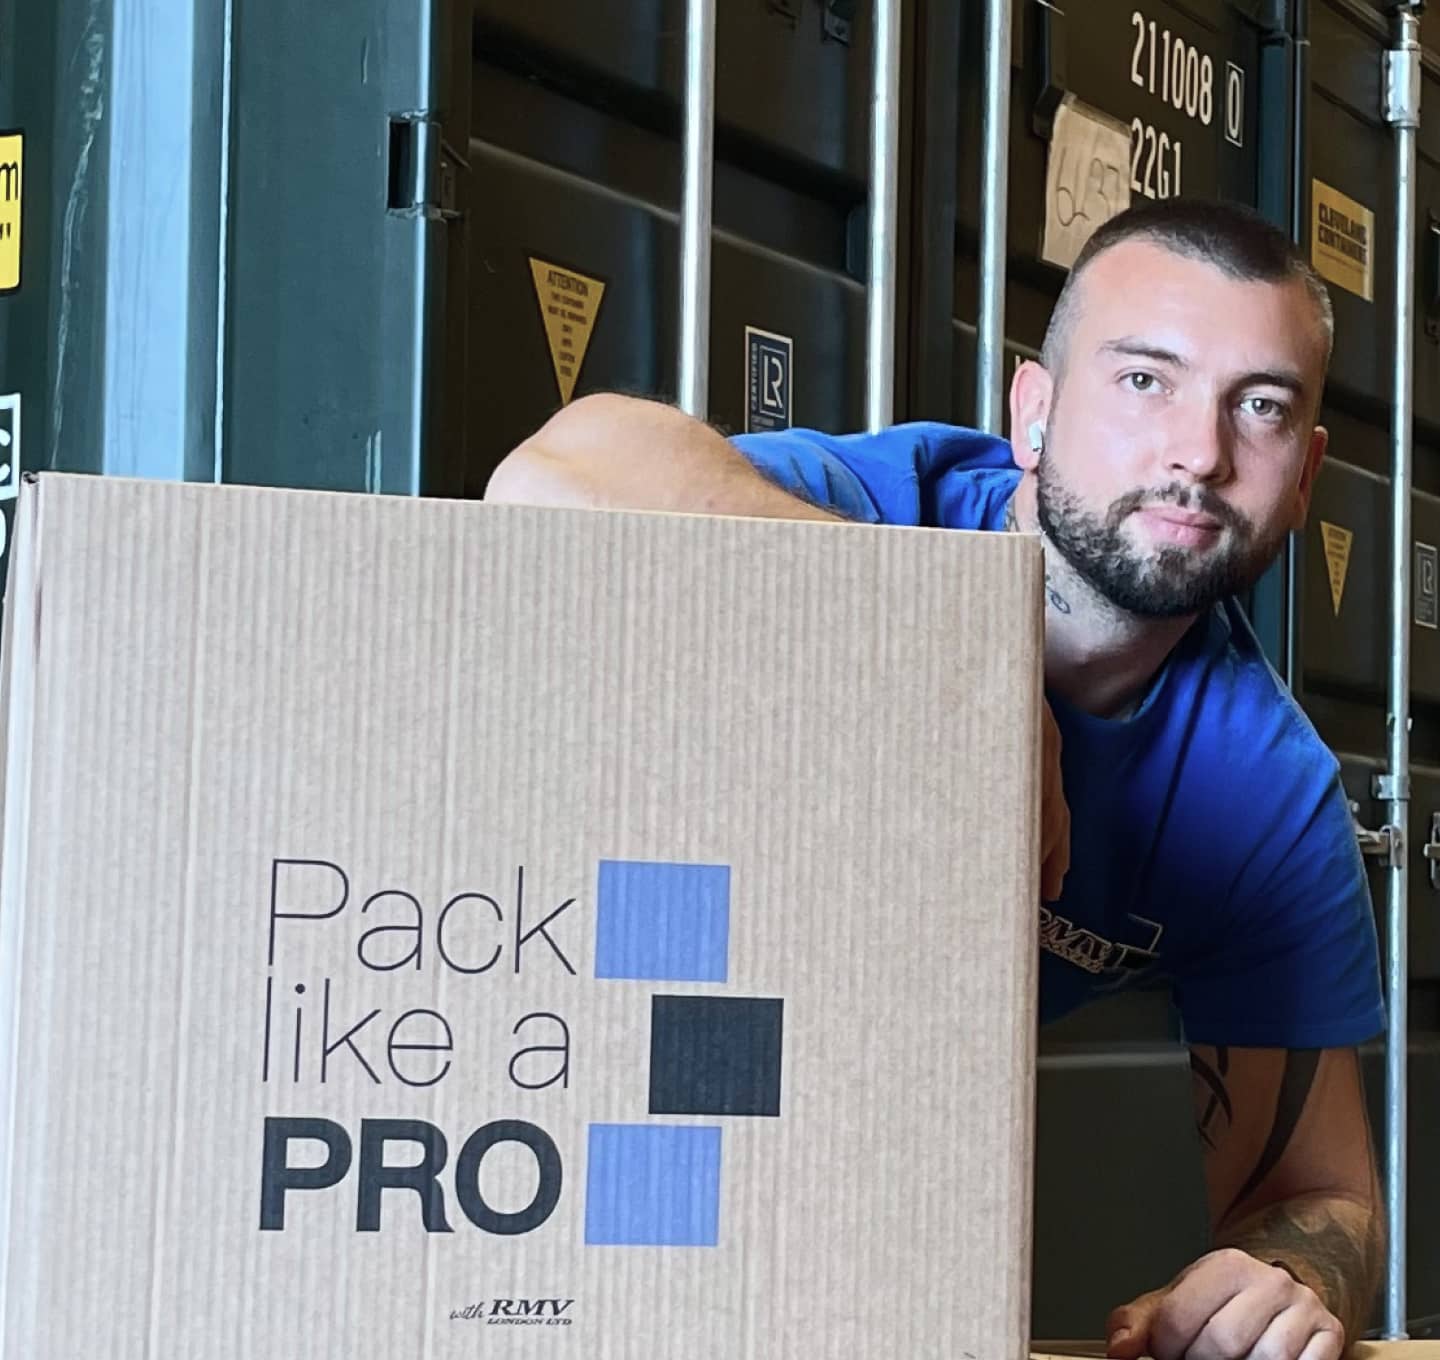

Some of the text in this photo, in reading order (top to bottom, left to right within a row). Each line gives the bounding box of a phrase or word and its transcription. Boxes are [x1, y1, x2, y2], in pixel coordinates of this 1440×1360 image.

[1131, 11, 1213, 125] 211008
[1131, 117, 1182, 200] 22G1
[269, 859, 577, 975] Pack
[263, 976, 570, 1089] like a
[258, 1115, 563, 1236] PRO
[449, 1299, 575, 1320] with RMV
[487, 1317, 573, 1326] LONDON LTD
